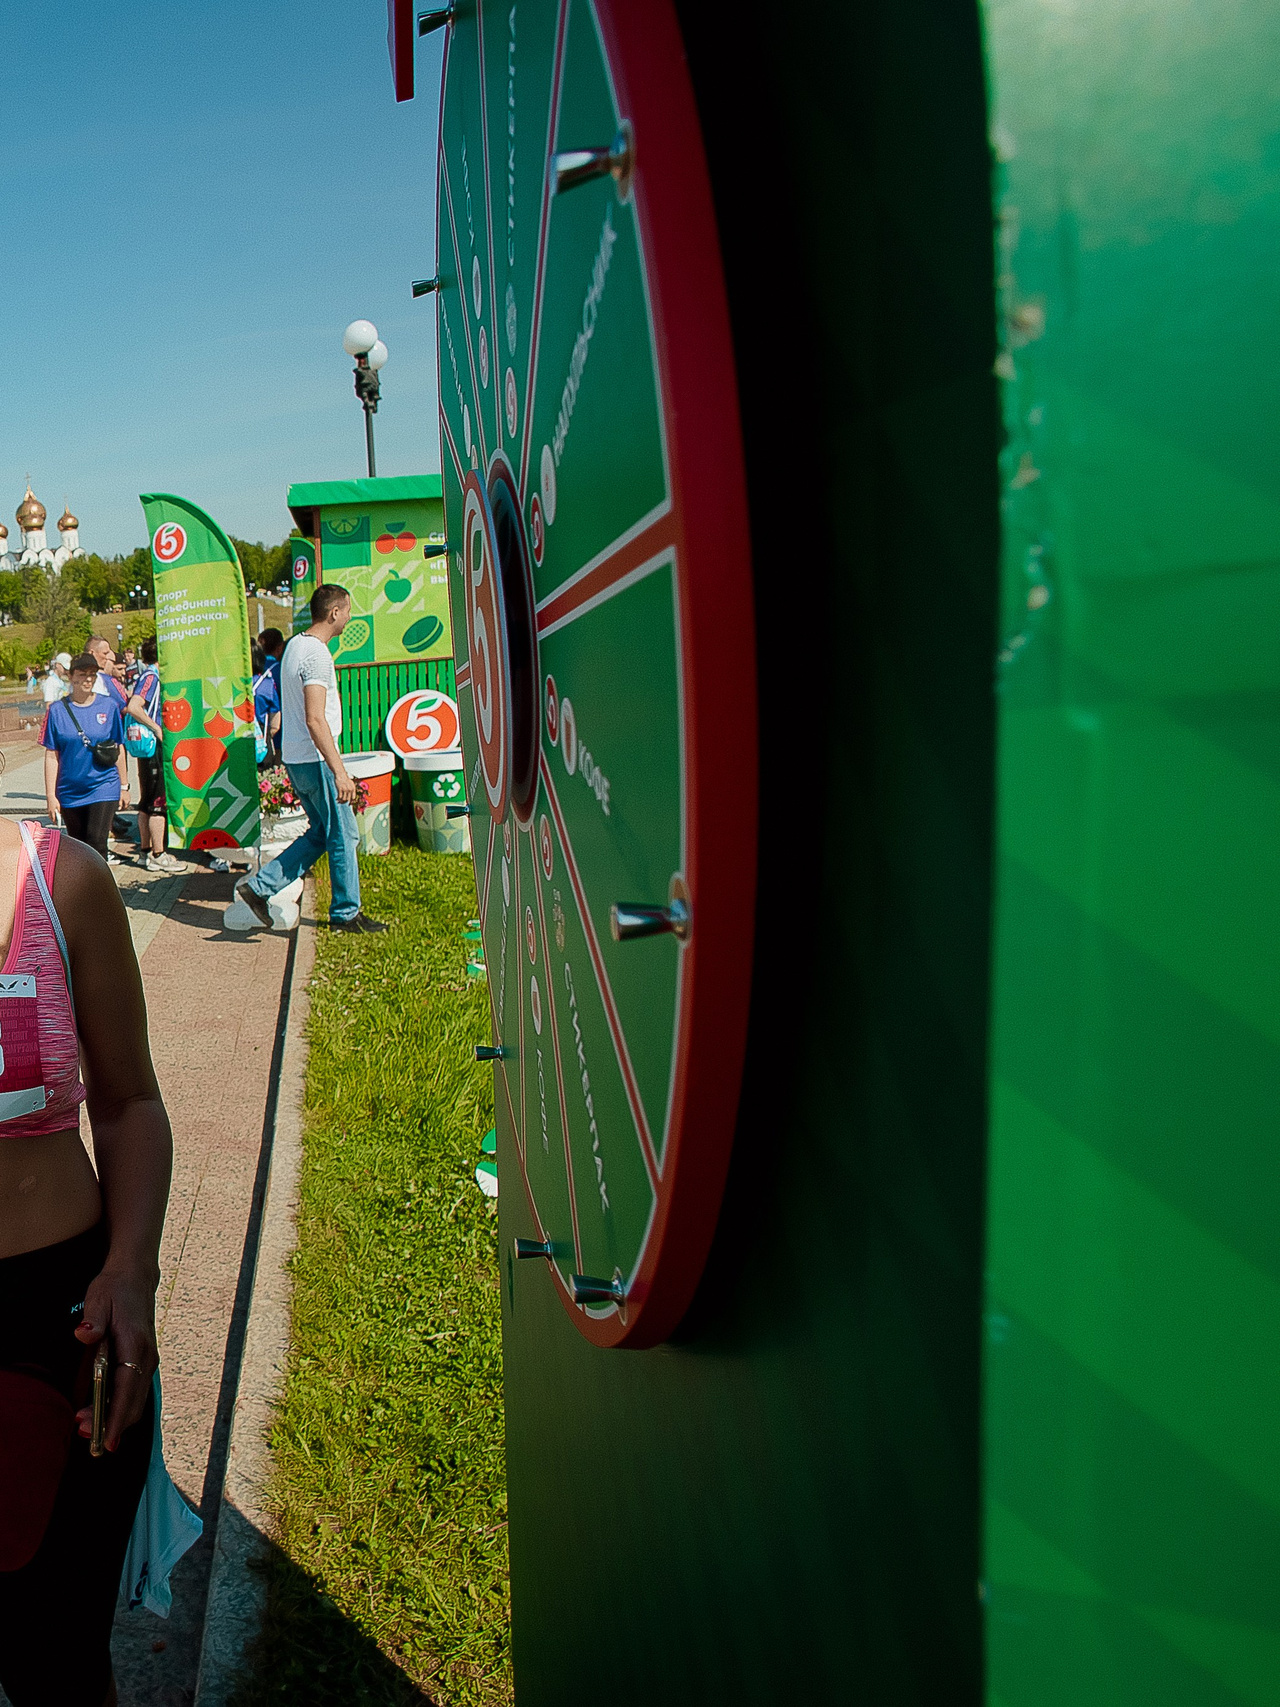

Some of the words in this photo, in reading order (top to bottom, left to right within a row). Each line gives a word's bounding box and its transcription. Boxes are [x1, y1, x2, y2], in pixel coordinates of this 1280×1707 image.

[157, 589, 188, 603] Спорт
[158, 596, 226, 617] объединяет!
[563, 961, 612, 1216] СТИКЕРПАК
